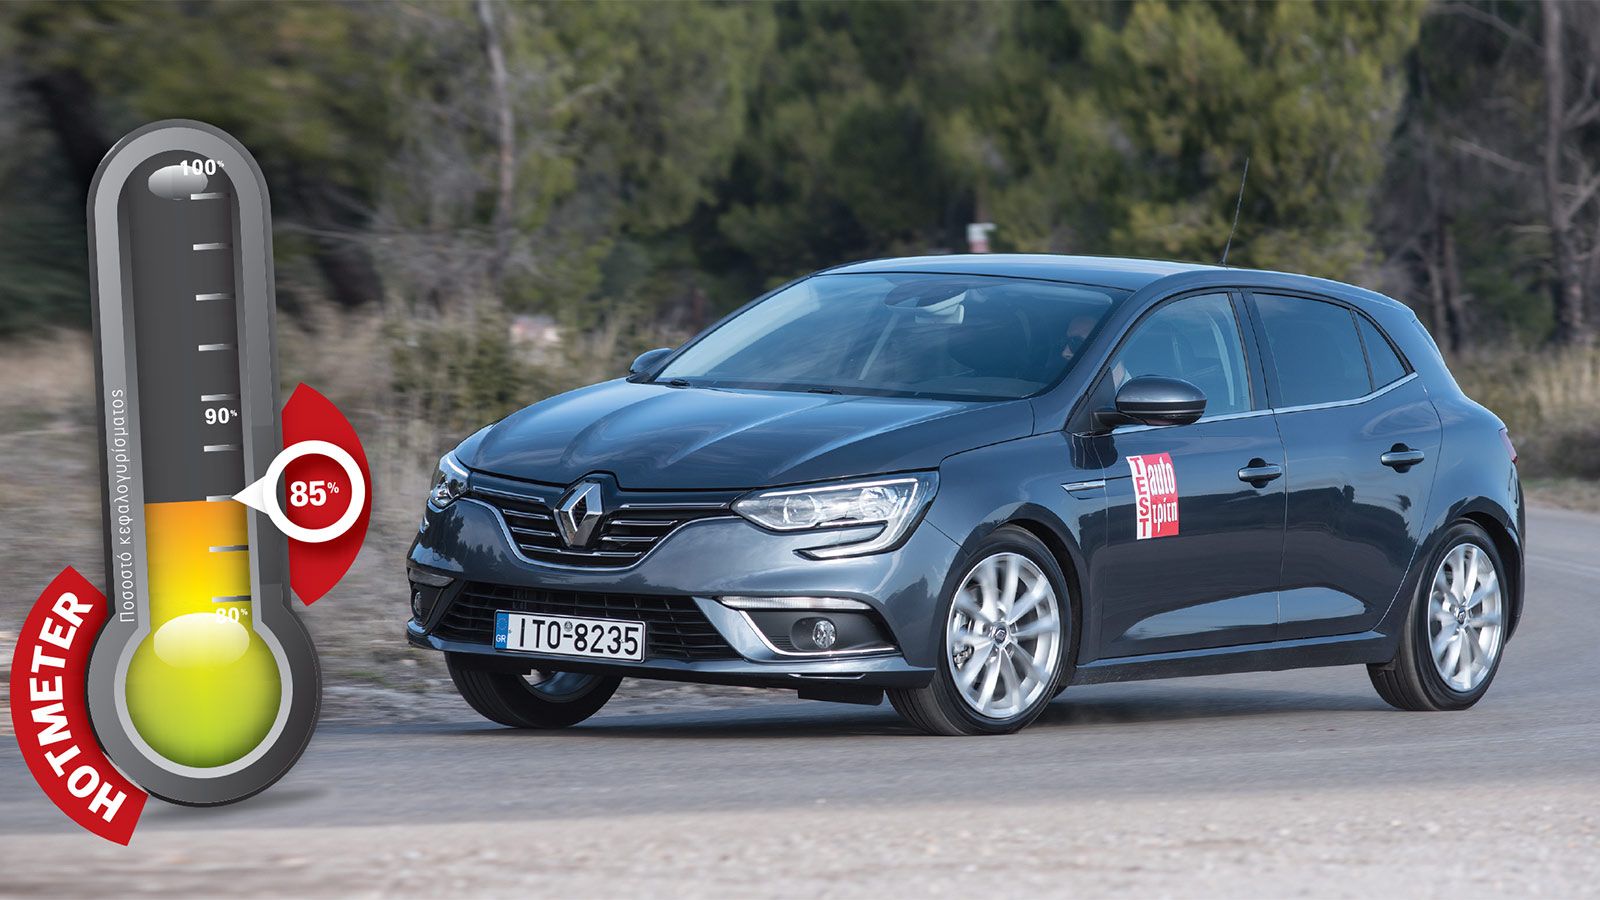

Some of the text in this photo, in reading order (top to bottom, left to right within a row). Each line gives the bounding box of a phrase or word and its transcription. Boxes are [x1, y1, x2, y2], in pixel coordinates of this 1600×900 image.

[1129, 457, 1150, 537] TEST
[1147, 456, 1176, 497] auto
[495, 634, 507, 644] GR
